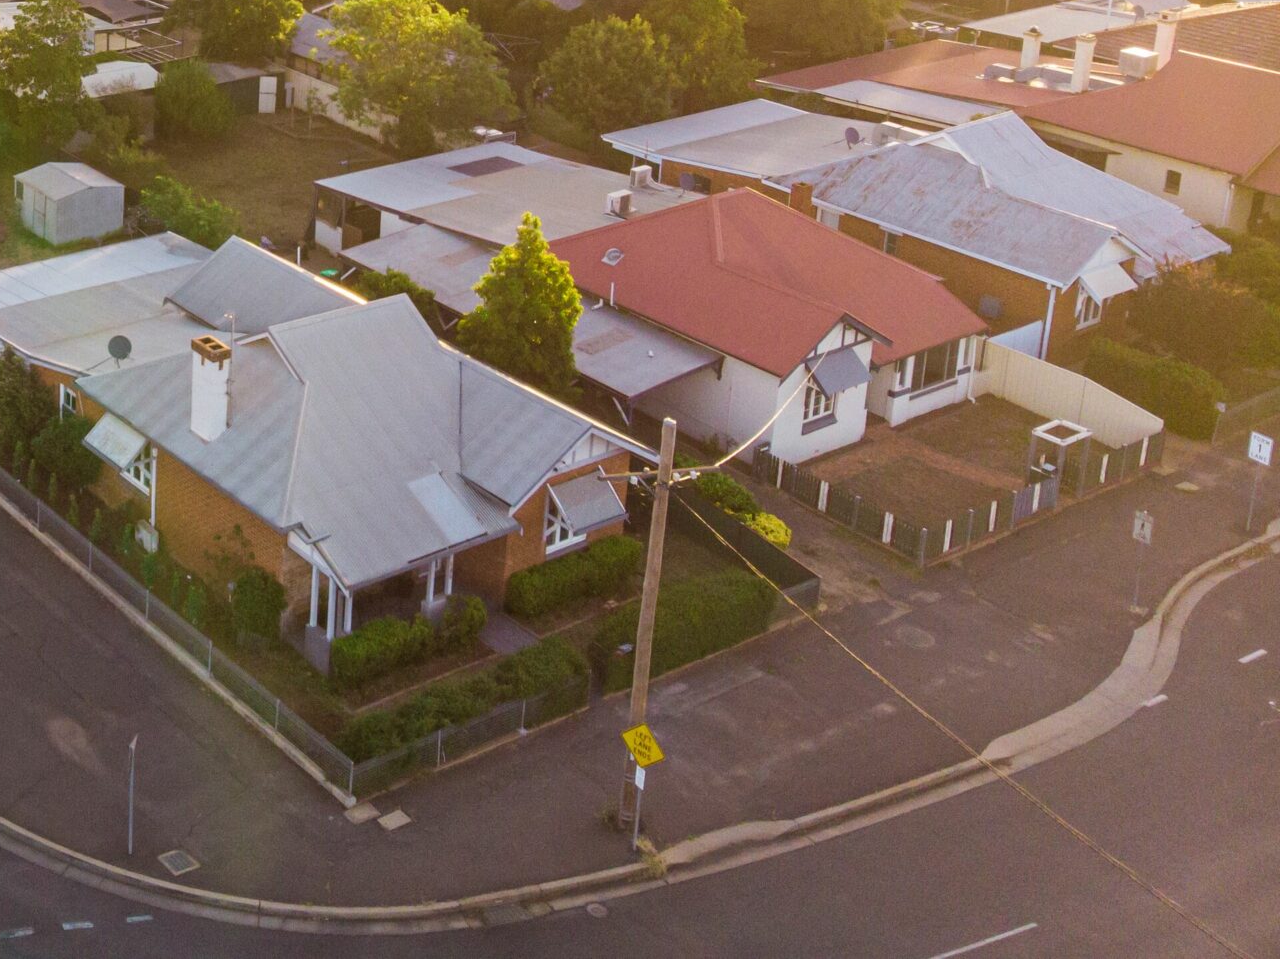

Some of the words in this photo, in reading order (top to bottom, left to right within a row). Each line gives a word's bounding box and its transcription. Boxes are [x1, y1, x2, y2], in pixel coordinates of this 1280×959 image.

[1258, 444, 1262, 454] 1
[1250, 452, 1266, 462] LANE
[635, 731, 652, 743] LEFT
[633, 738, 651, 752] LANE
[633, 747, 651, 761] ENDS
